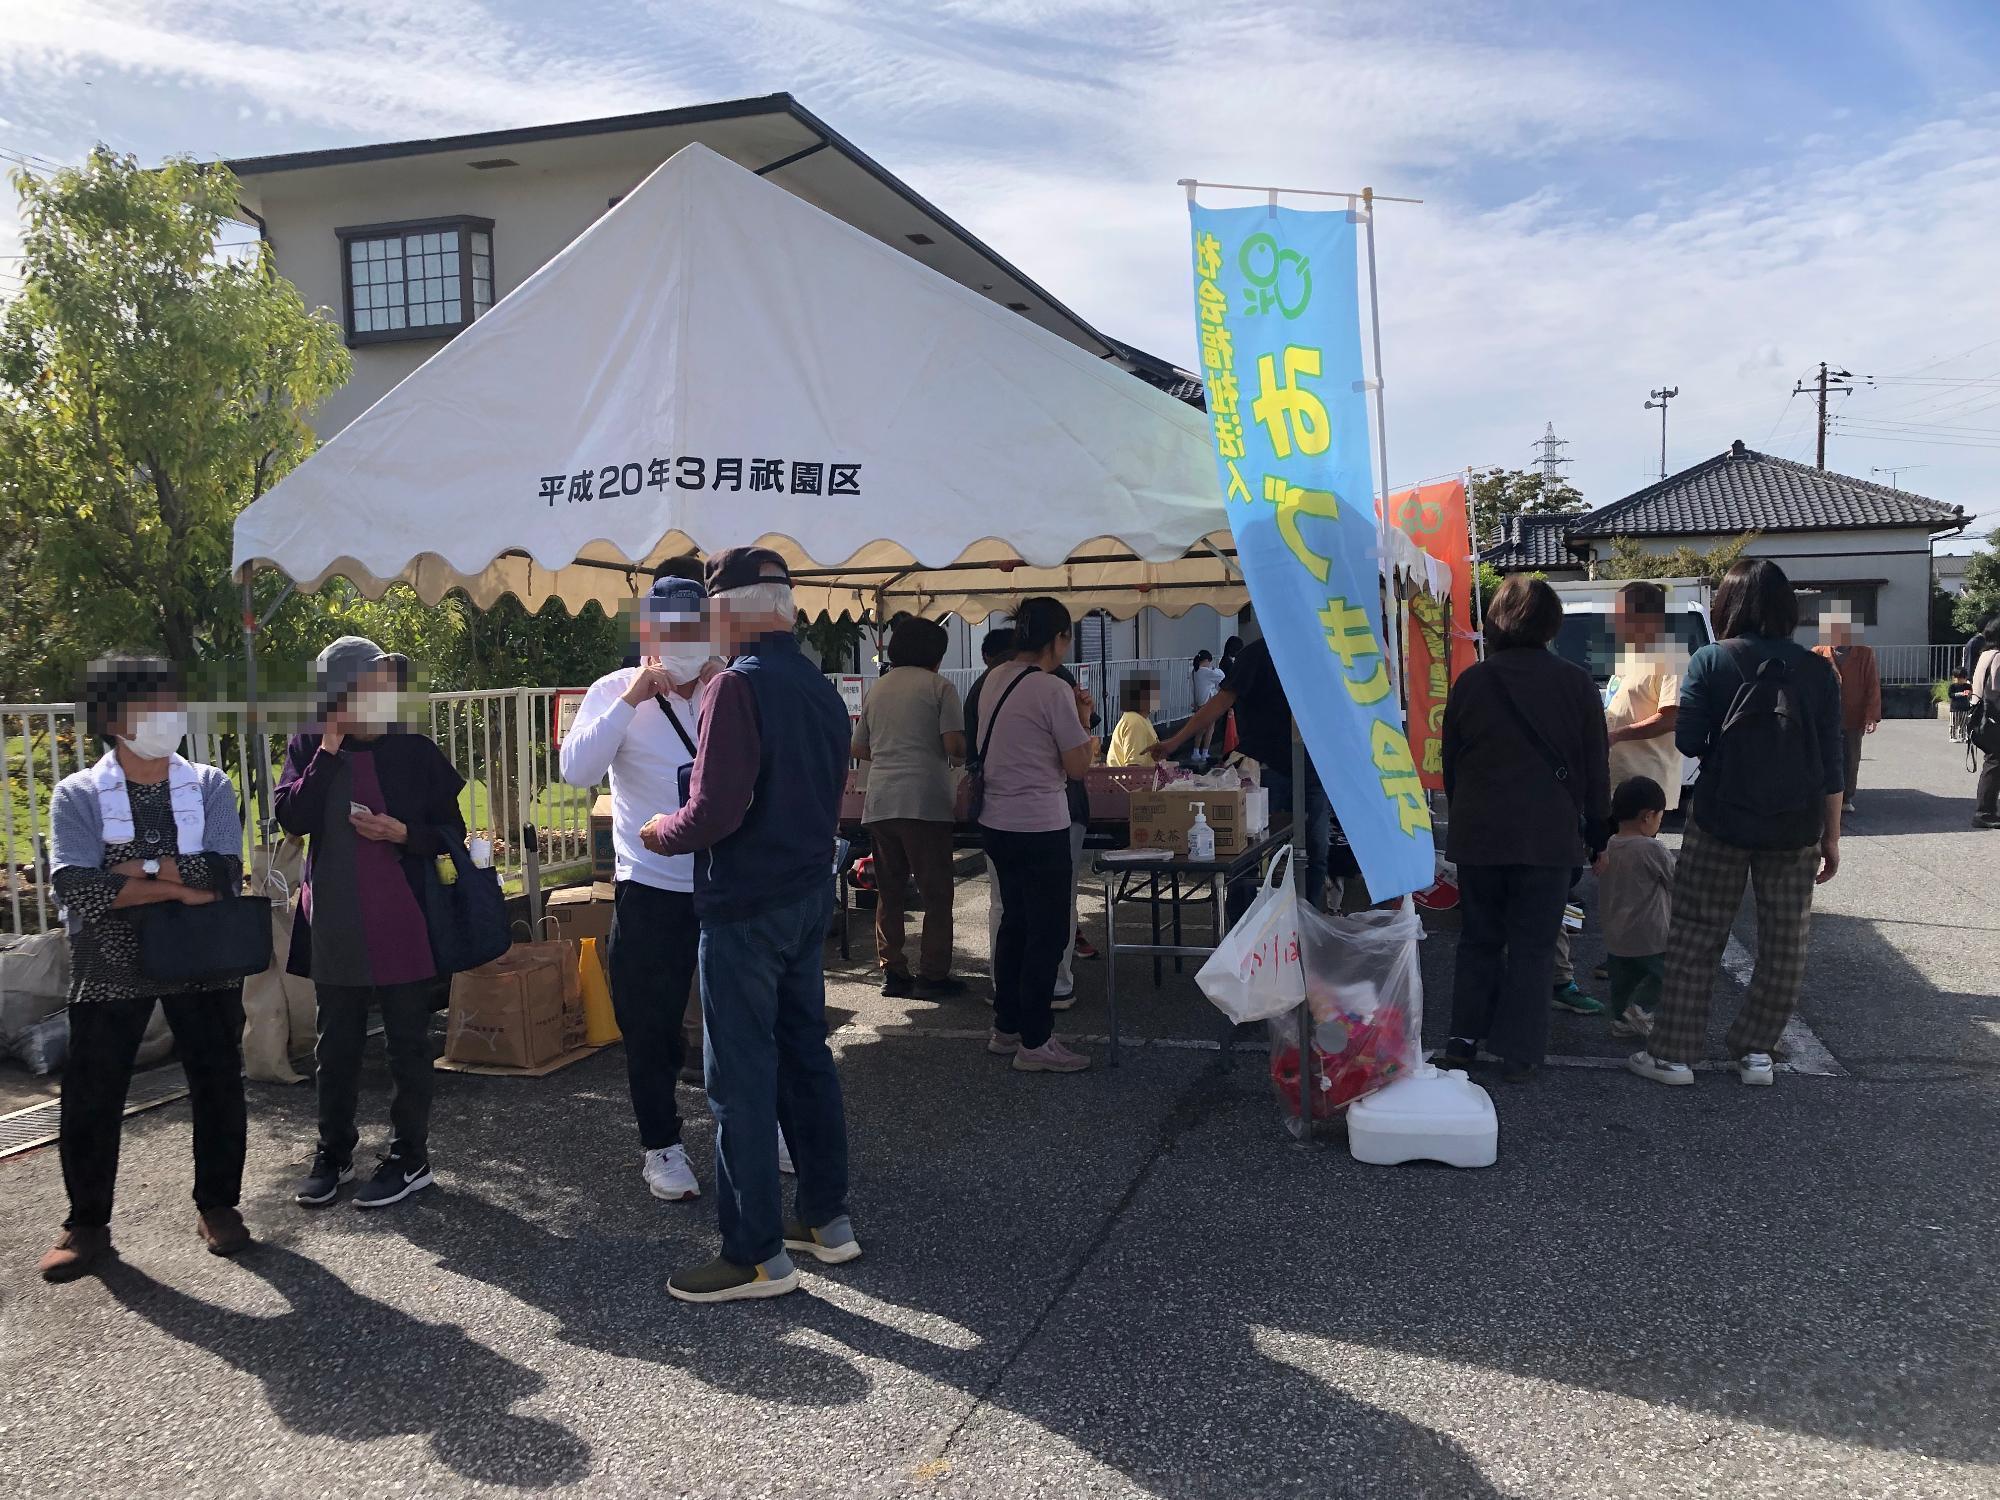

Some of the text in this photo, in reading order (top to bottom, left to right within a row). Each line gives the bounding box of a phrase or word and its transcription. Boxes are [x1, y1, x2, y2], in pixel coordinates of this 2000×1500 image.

[538, 456, 862, 506] 平成20年3月祇園区
